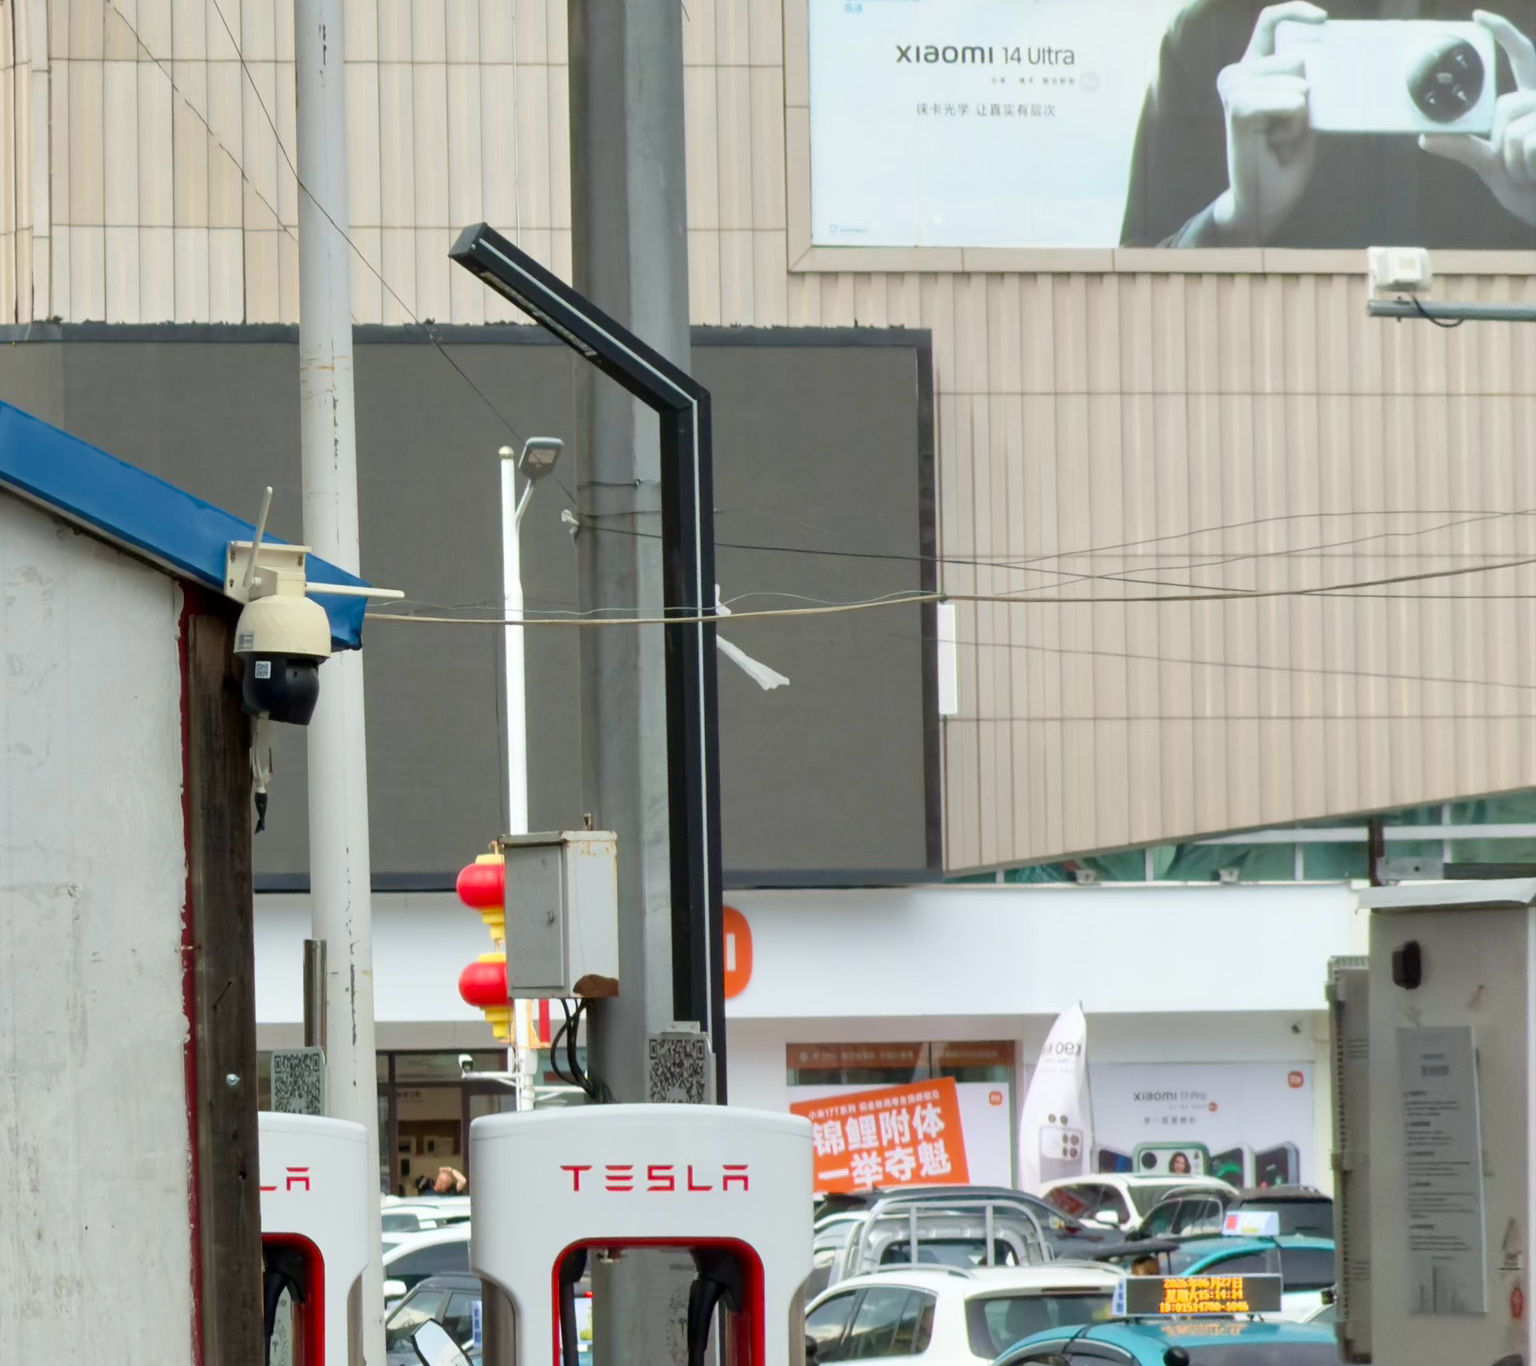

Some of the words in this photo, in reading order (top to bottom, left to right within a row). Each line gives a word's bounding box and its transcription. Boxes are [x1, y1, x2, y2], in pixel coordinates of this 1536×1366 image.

[1002, 46, 1022, 65] 14
[1028, 46, 1076, 66] Ultra
[813, 1103, 945, 1157] 锦鲤附体
[560, 1164, 750, 1193] TESLA
[818, 1138, 952, 1189] 一举夺魁
